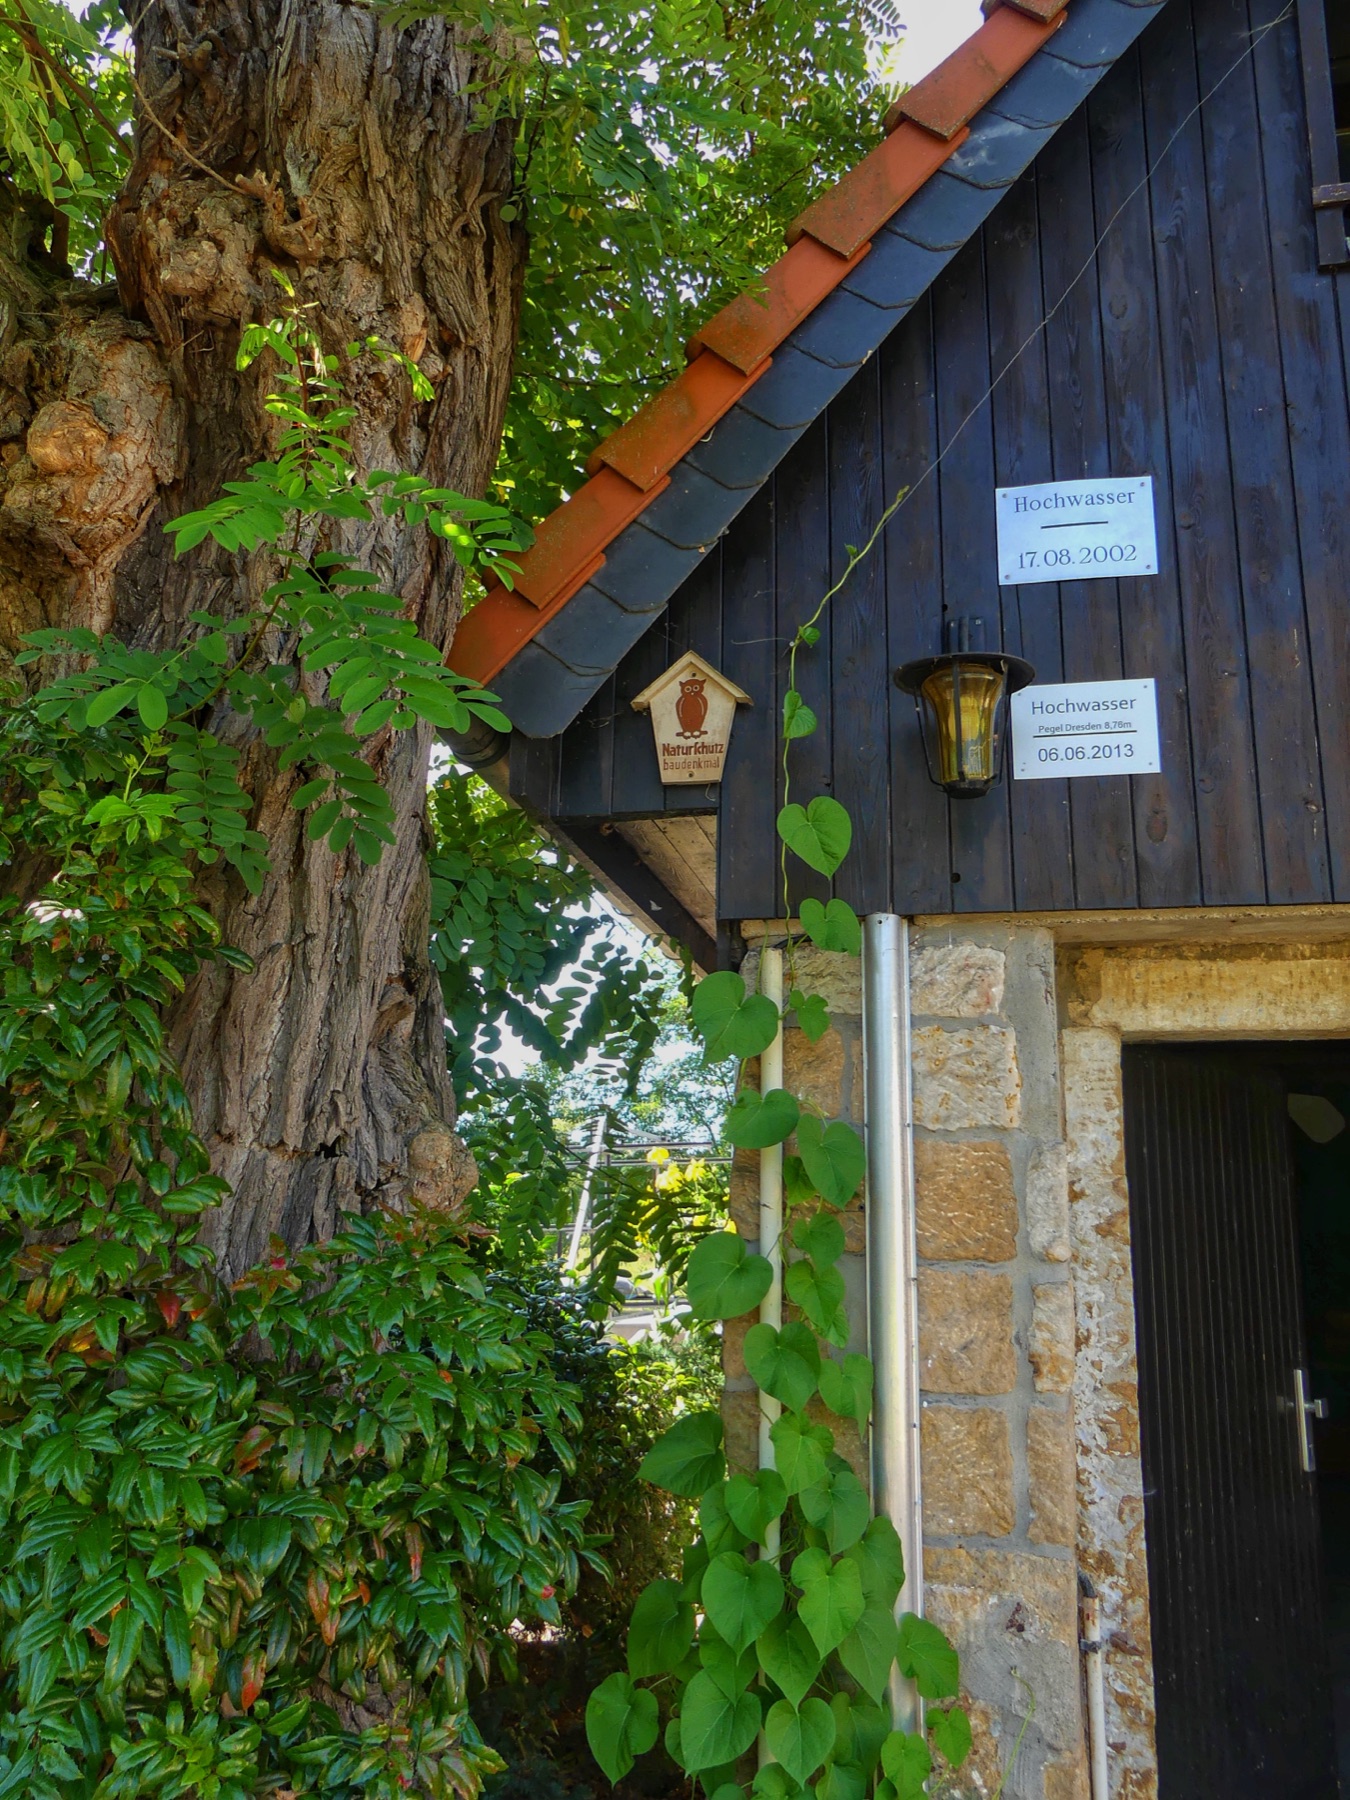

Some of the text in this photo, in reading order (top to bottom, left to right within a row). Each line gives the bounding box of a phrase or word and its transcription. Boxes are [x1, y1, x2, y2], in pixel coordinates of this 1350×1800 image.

[1014, 491, 1135, 513] Hochwasser
[1018, 544, 1137, 569] 17.08.2002
[1031, 698, 1137, 715] Hochwasser
[1038, 723, 1063, 734] Pegel
[1065, 722, 1102, 732] Dresden
[1038, 743, 1134, 762] 06.06.2013
[663, 757, 720, 770] baudenkmal
